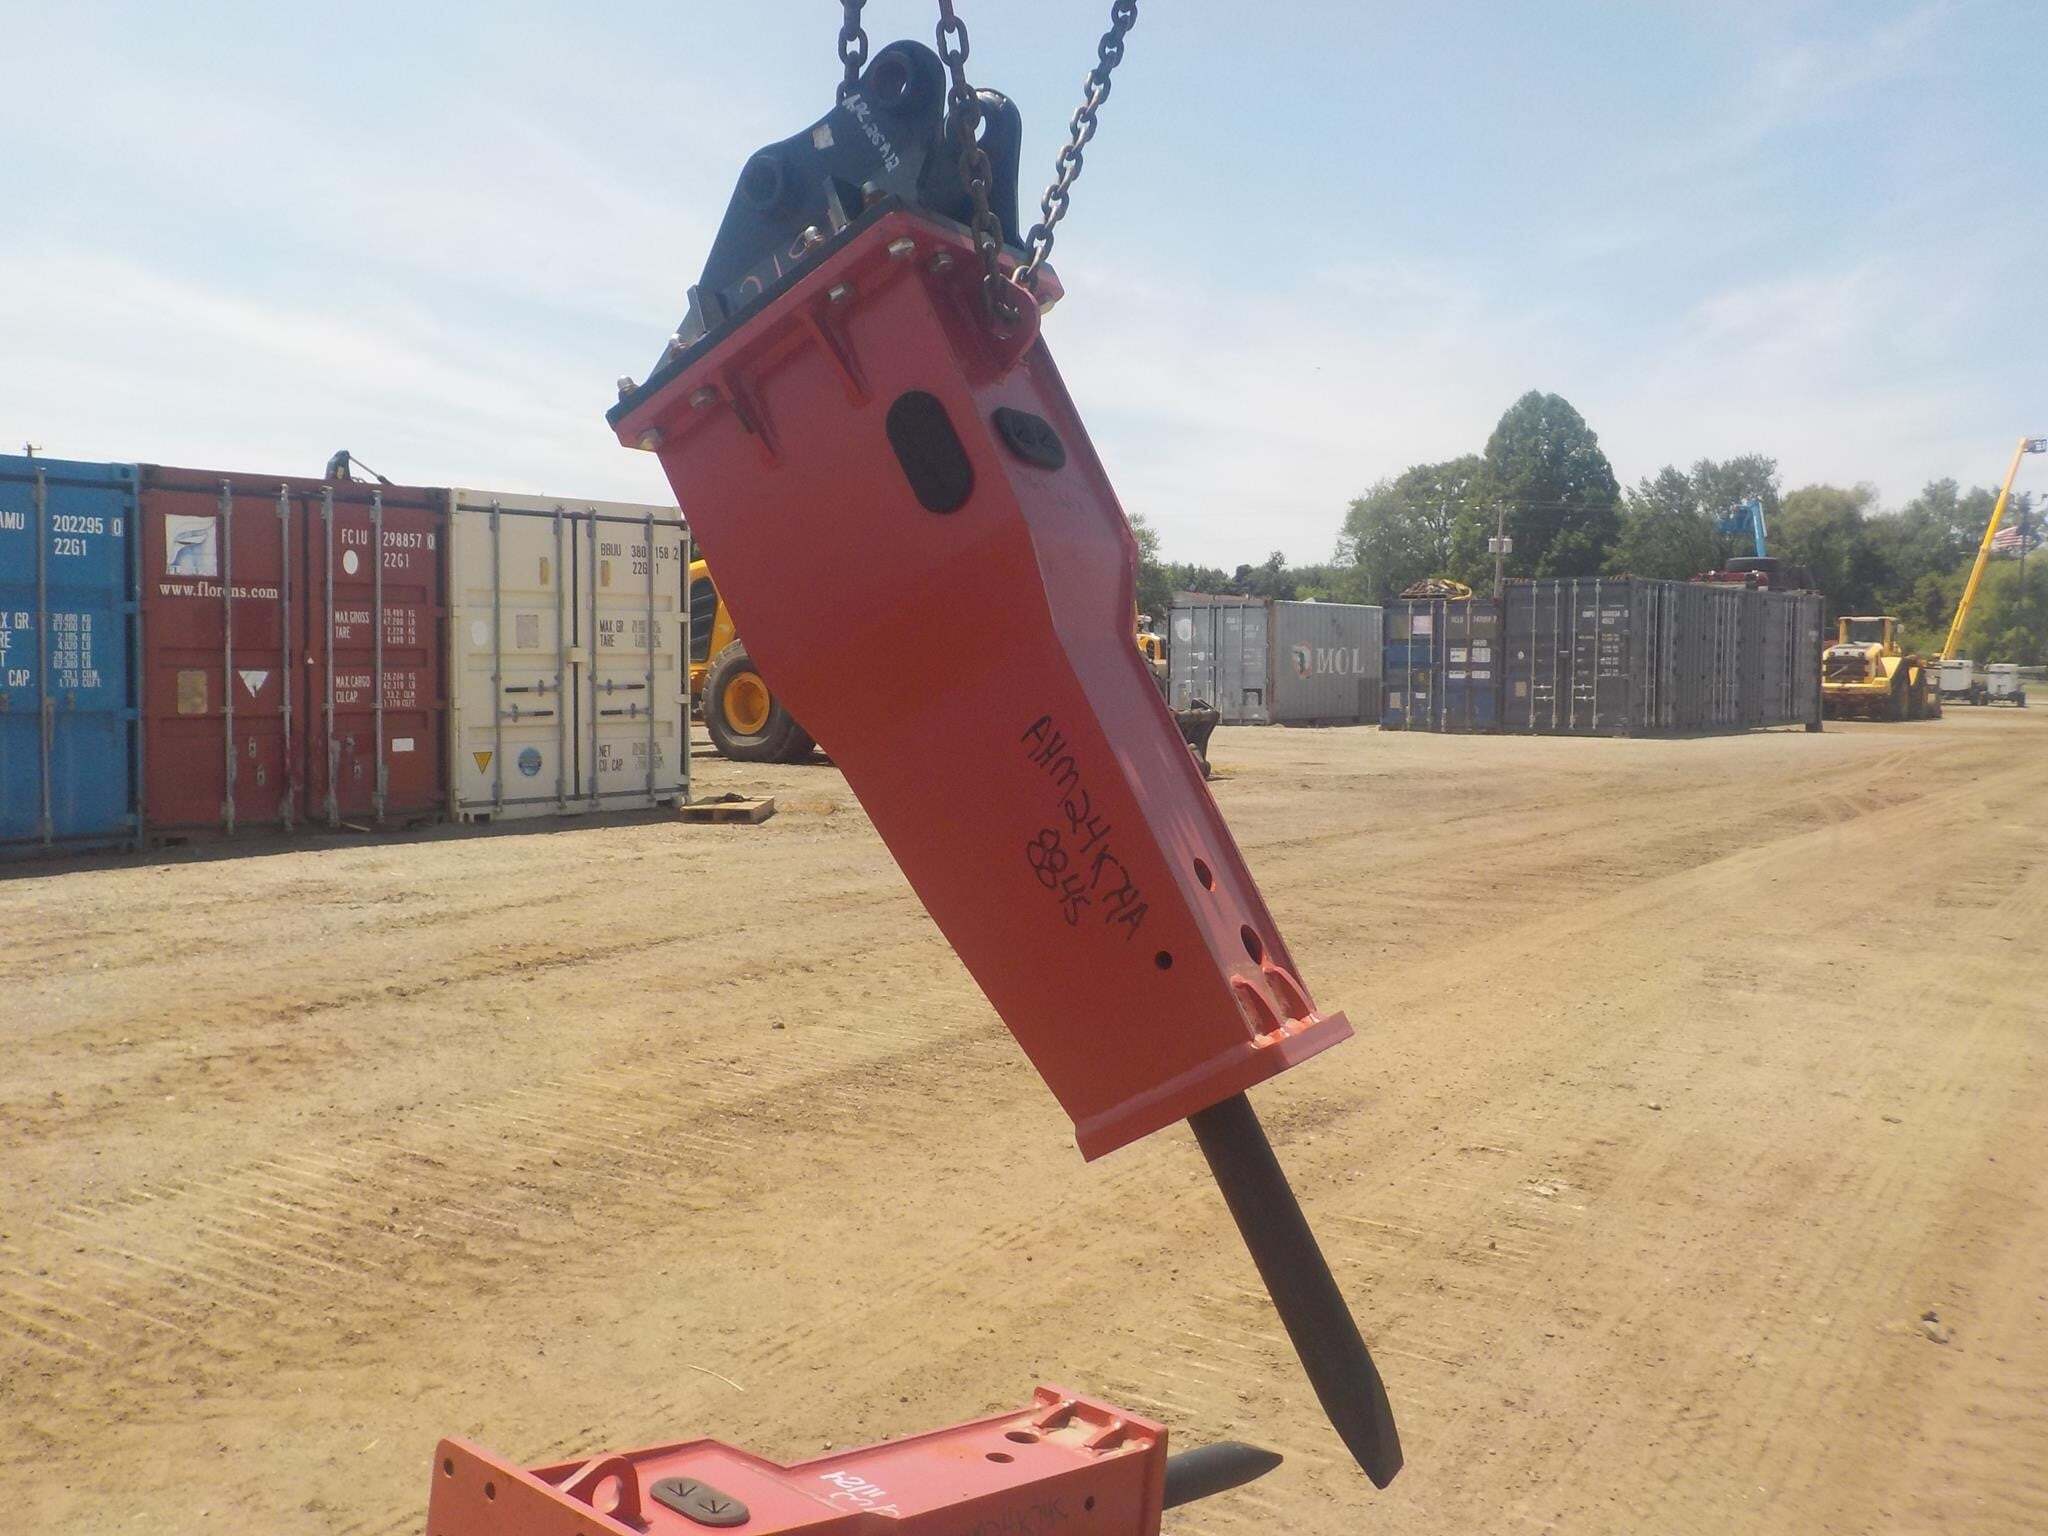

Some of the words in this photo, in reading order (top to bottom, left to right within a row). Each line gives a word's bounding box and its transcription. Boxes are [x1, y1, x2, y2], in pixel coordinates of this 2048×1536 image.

[53, 515, 103, 534] 202295
[113, 518, 122, 536] 0
[54, 538, 86, 556] 22G1
[341, 528, 368, 545] FCIU
[383, 532, 422, 548] 298857
[384, 553, 409, 568] 22G1
[673, 547, 680, 560] 2
[159, 581, 278, 599] www.florns.com
[1315, 647, 1365, 676] MOL
